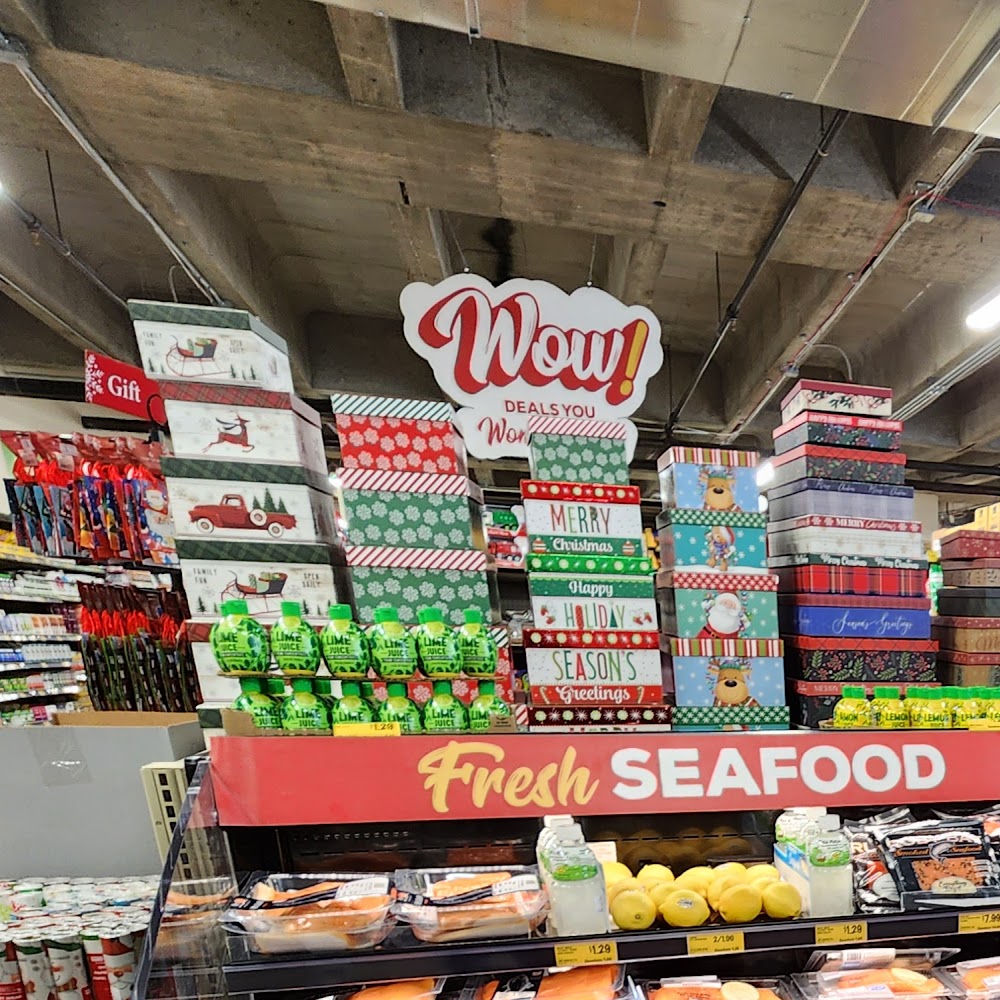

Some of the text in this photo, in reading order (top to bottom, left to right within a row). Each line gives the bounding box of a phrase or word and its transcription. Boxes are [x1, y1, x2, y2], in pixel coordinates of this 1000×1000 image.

[417, 287, 650, 406] Wow!
[107, 373, 142, 403] Gift
[504, 399, 596, 419] DEALS YOU
[550, 503, 611, 535] MERRY
[836, 518, 865, 528] MERRY
[552, 537, 614, 554] Christmas
[193, 568, 218, 576] FAMILY
[195, 577, 208, 585] FUN
[568, 580, 614, 598] Happy
[564, 602, 626, 630] HOLIDAY
[275, 632, 302, 643] LIME
[326, 635, 352, 646] LIME
[424, 638, 447, 647] LIME
[279, 643, 301, 651] JUICE
[384, 640, 410, 649] LIME
[330, 646, 350, 654] JUICE
[387, 649, 409, 657] JUICE
[427, 647, 447, 655] JUICE
[552, 650, 637, 682] SEASON'S
[555, 685, 631, 703] Greetings
[296, 709, 320, 719] LIME
[388, 713, 412, 723] LIME
[432, 709, 456, 719] LIME
[471, 710, 490, 720] LIM
[435, 719, 456, 727] JUICE
[417, 740, 946, 814] Fresh SEAFOOD
[894, 848, 930, 858] Smoked
[843, 924, 863, 935] $1.29
[588, 943, 611, 955] $1.29
